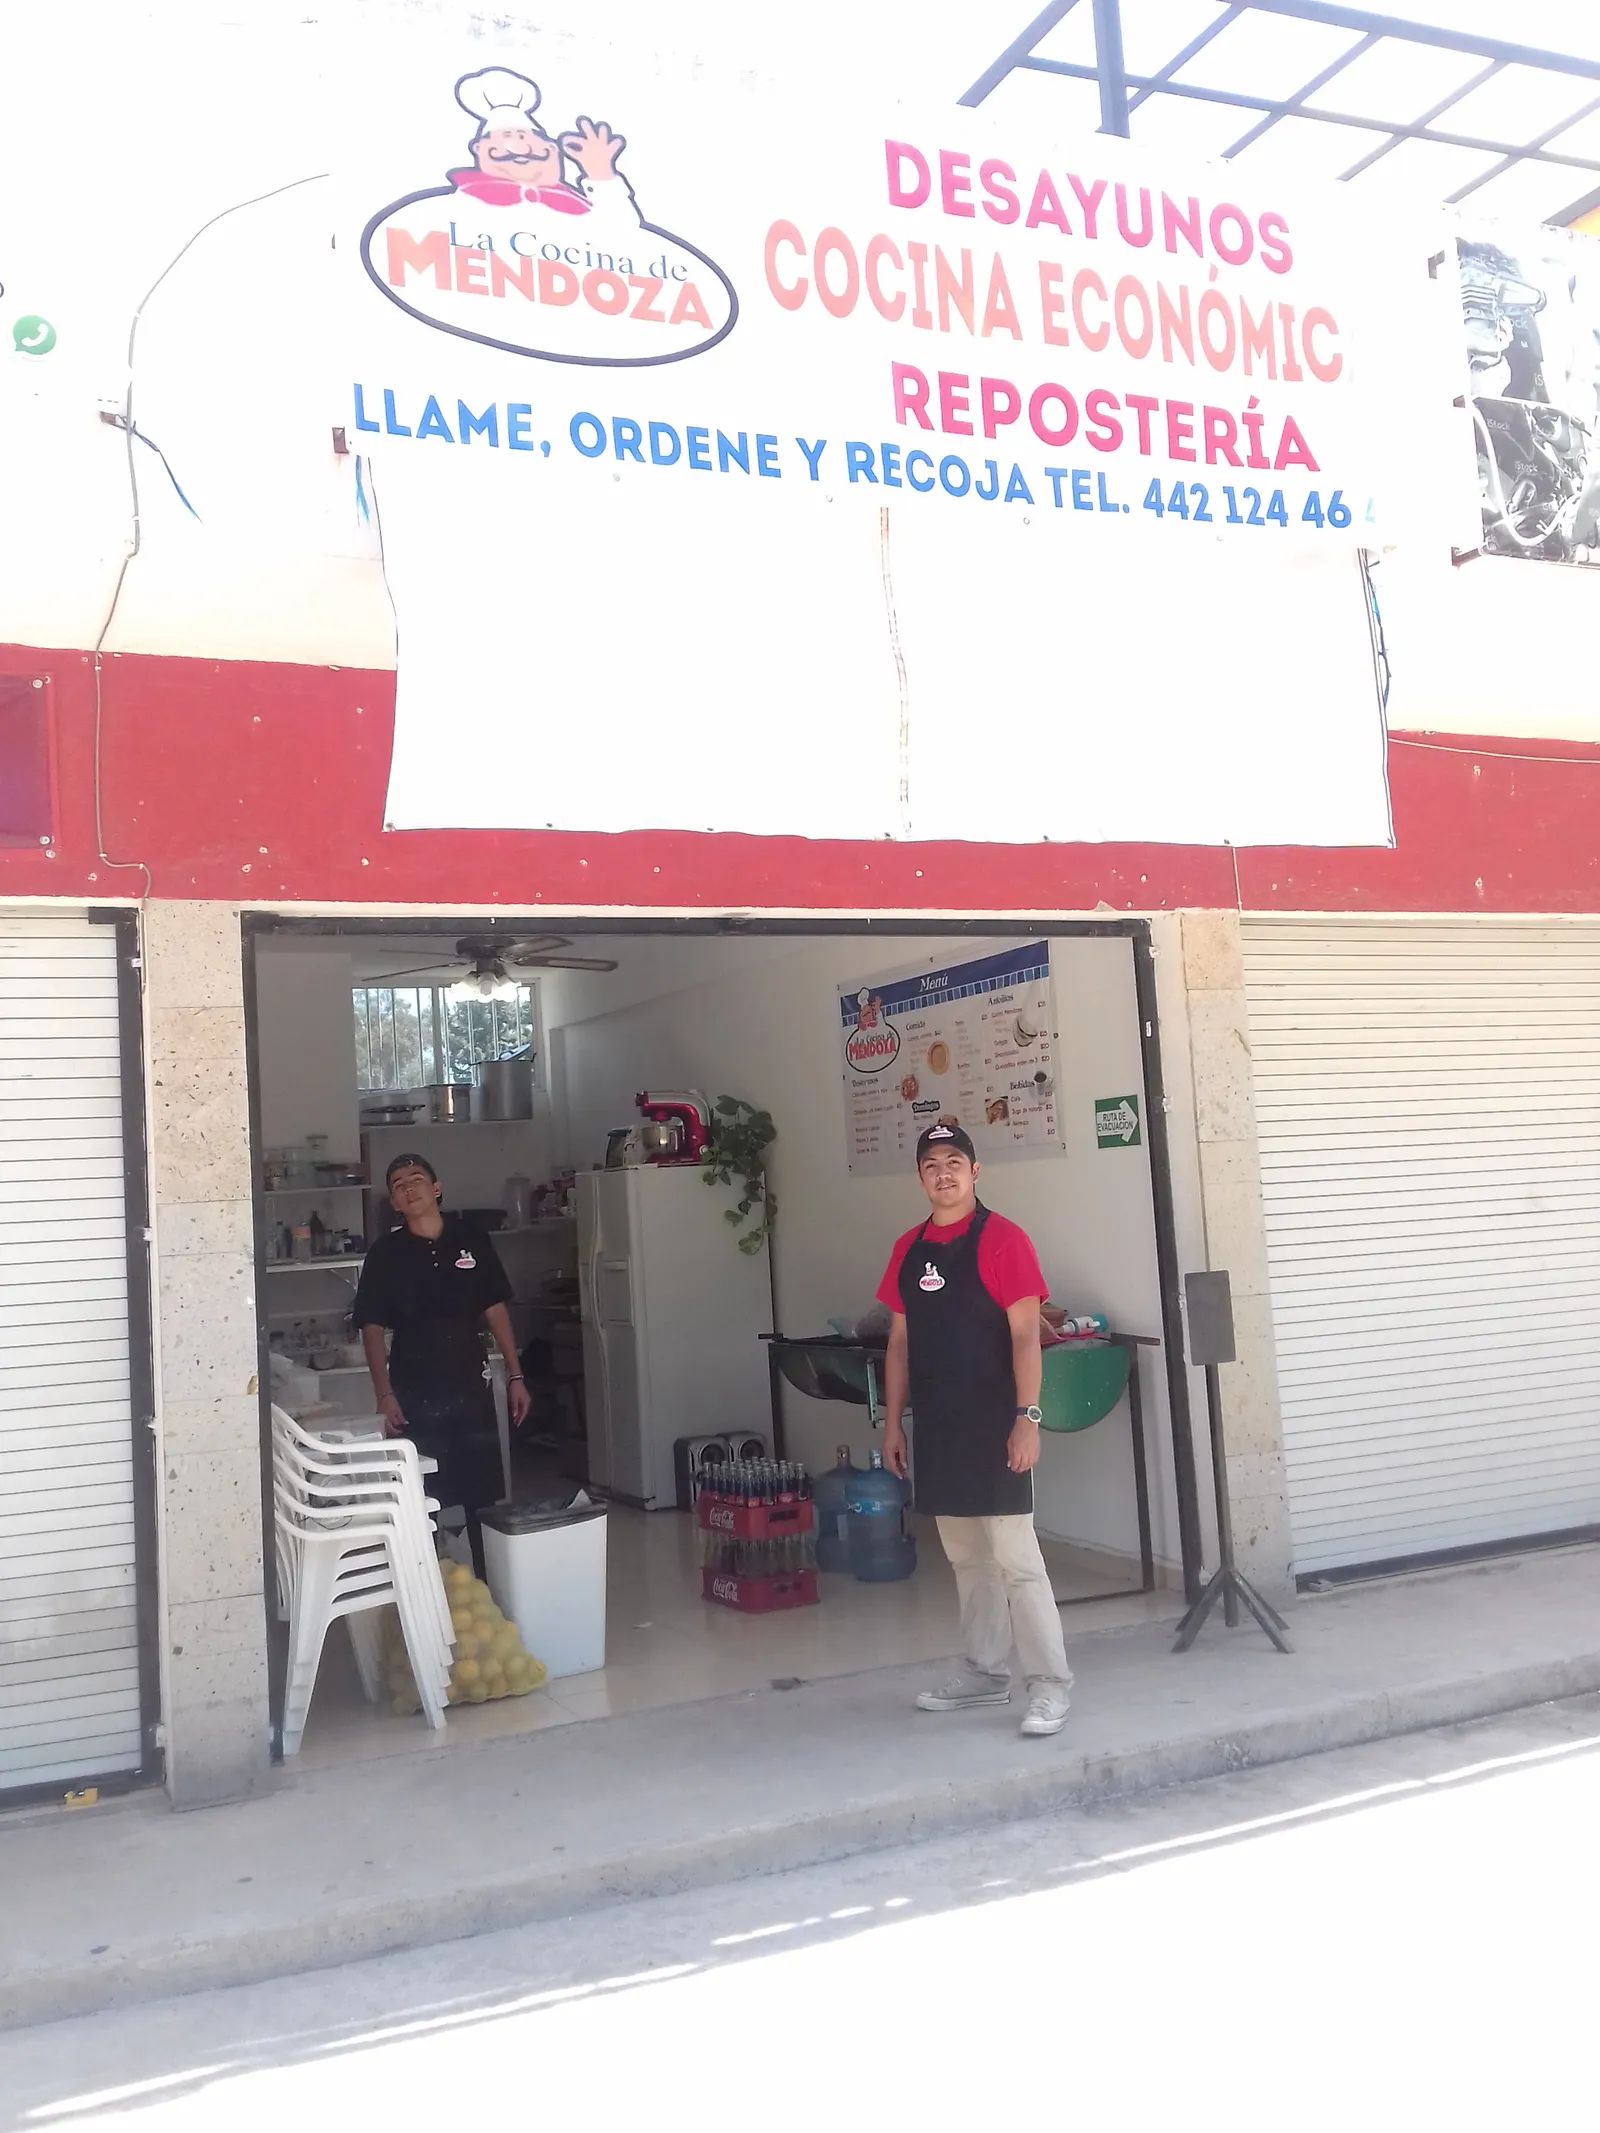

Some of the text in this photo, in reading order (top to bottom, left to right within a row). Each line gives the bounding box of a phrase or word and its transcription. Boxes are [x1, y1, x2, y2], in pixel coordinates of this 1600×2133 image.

[449, 221, 689, 282] La Cocina de
[884, 139, 1293, 275] DESAYUNOS
[387, 228, 713, 329] MENDOZA
[765, 220, 1342, 383] COCINA ECONÓMIC
[353, 383, 552, 460] LLAME,
[569, 411, 782, 479] ORDENE
[795, 437, 827, 482] Y
[845, 441, 1035, 505] RECOJA
[1043, 467, 1131, 516] TEL.
[1143, 478, 1213, 523] 442
[1222, 485, 1289, 529] 124
[1301, 490, 1352, 529] 46
[891, 361, 1321, 473] REPOSTERÍA
[919, 972, 949, 992] Menú
[848, 1037, 897, 1061] MENDOZA
[1103, 1112, 1126, 1122] RUTA DE
